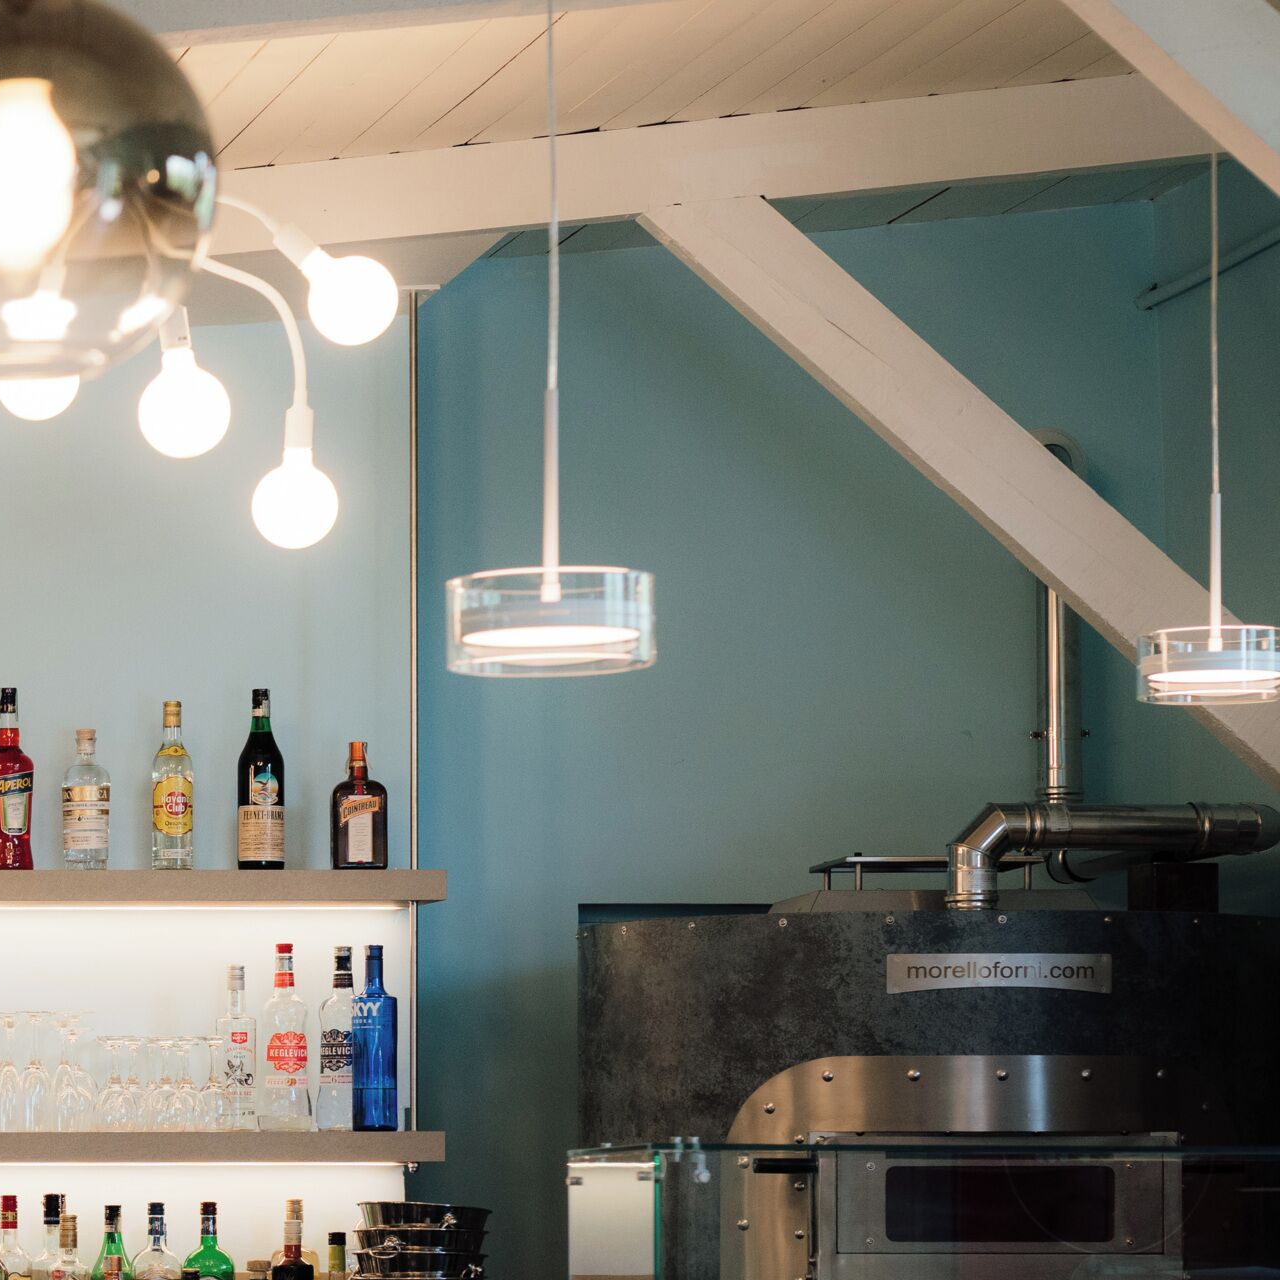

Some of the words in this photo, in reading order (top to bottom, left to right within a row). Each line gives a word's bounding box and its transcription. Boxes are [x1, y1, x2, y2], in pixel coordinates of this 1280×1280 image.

[166, 803, 185, 812] Club
[343, 801, 377, 819] COINTREAU
[907, 961, 1096, 980] morelloforni.com
